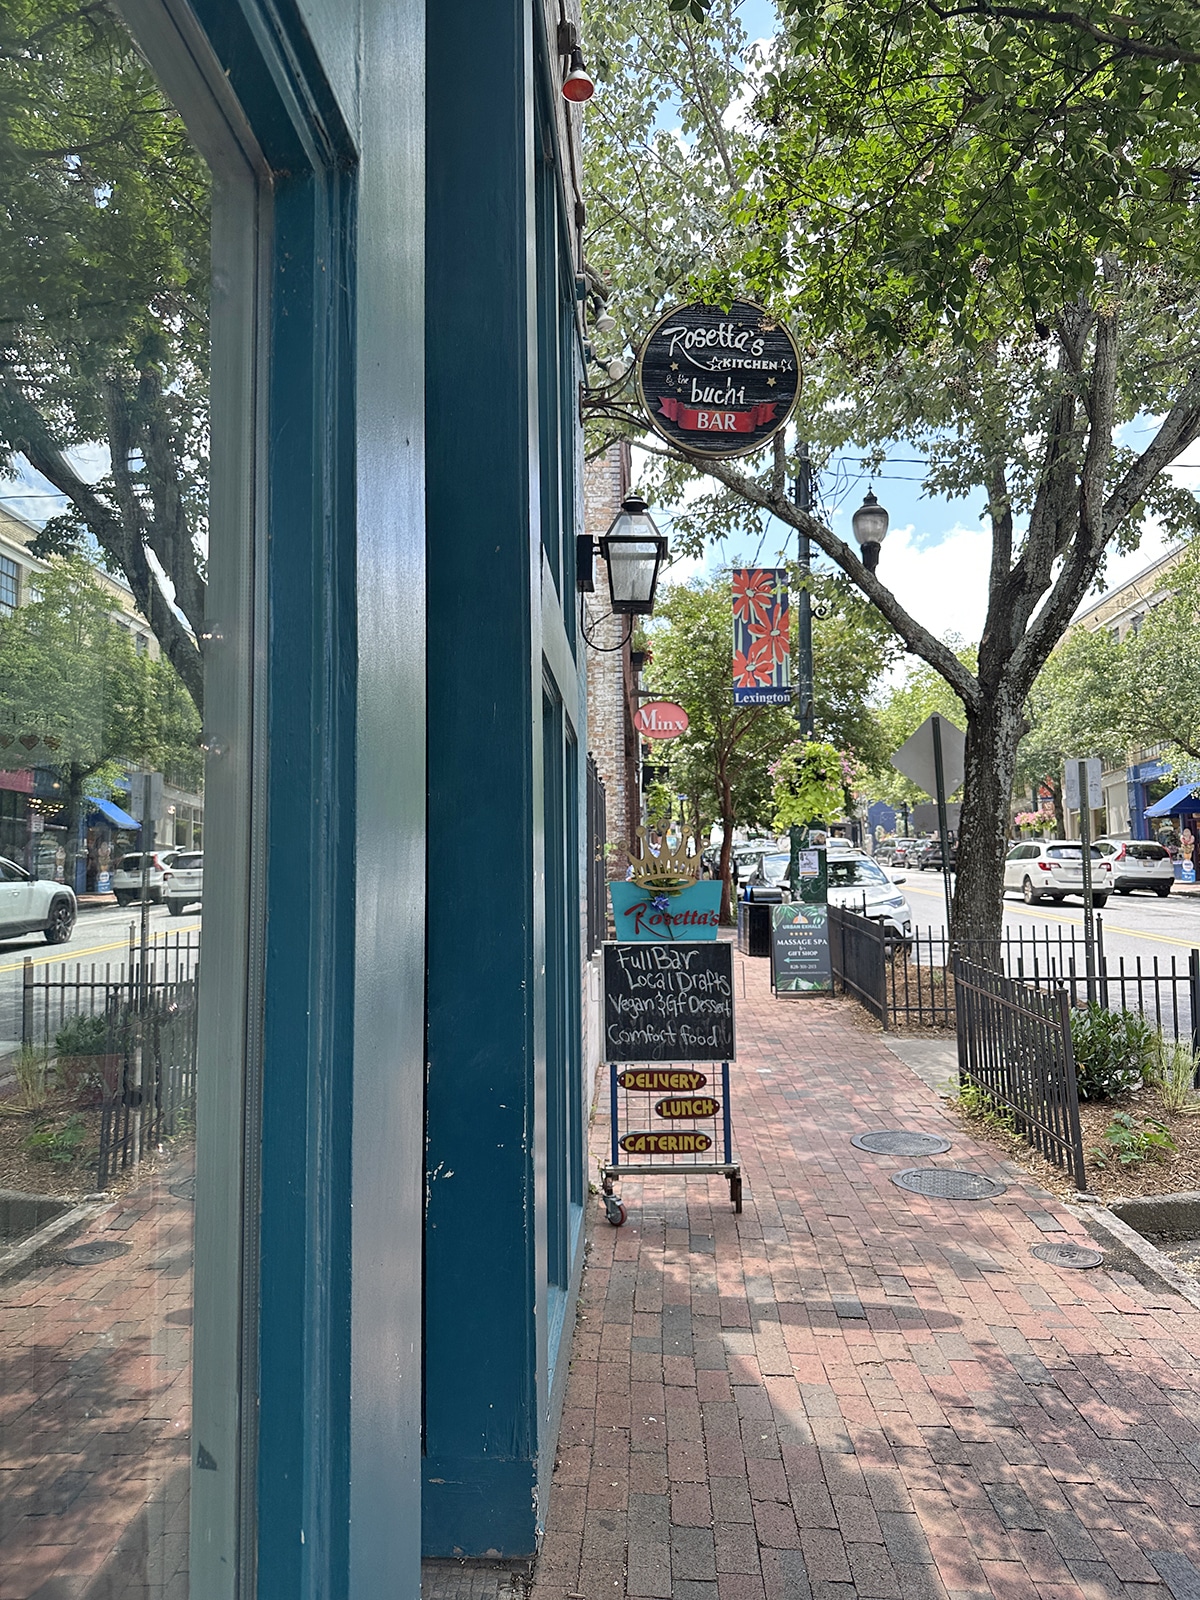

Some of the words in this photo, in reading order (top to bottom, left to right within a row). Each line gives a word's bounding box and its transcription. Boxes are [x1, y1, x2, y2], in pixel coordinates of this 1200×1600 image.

[662, 323, 765, 371] Rosetta's
[722, 358, 778, 370] KITCHEN
[691, 376, 745, 405] buchi
[697, 412, 737, 430] BAR
[735, 692, 791, 705] Lexington
[638, 709, 685, 731] Minx
[624, 903, 720, 939] Rosetta's
[616, 946, 652, 971] Full
[651, 946, 699, 970] Bar
[625, 968, 674, 991] Local
[676, 969, 731, 996] Drafts
[608, 993, 655, 1019] Vegan
[688, 995, 731, 1017] Dessert
[608, 1023, 677, 1045] Comfort
[624, 1073, 700, 1089] DELIVERY
[662, 1100, 714, 1117] LUNCH
[624, 1135, 707, 1151] CATERING
